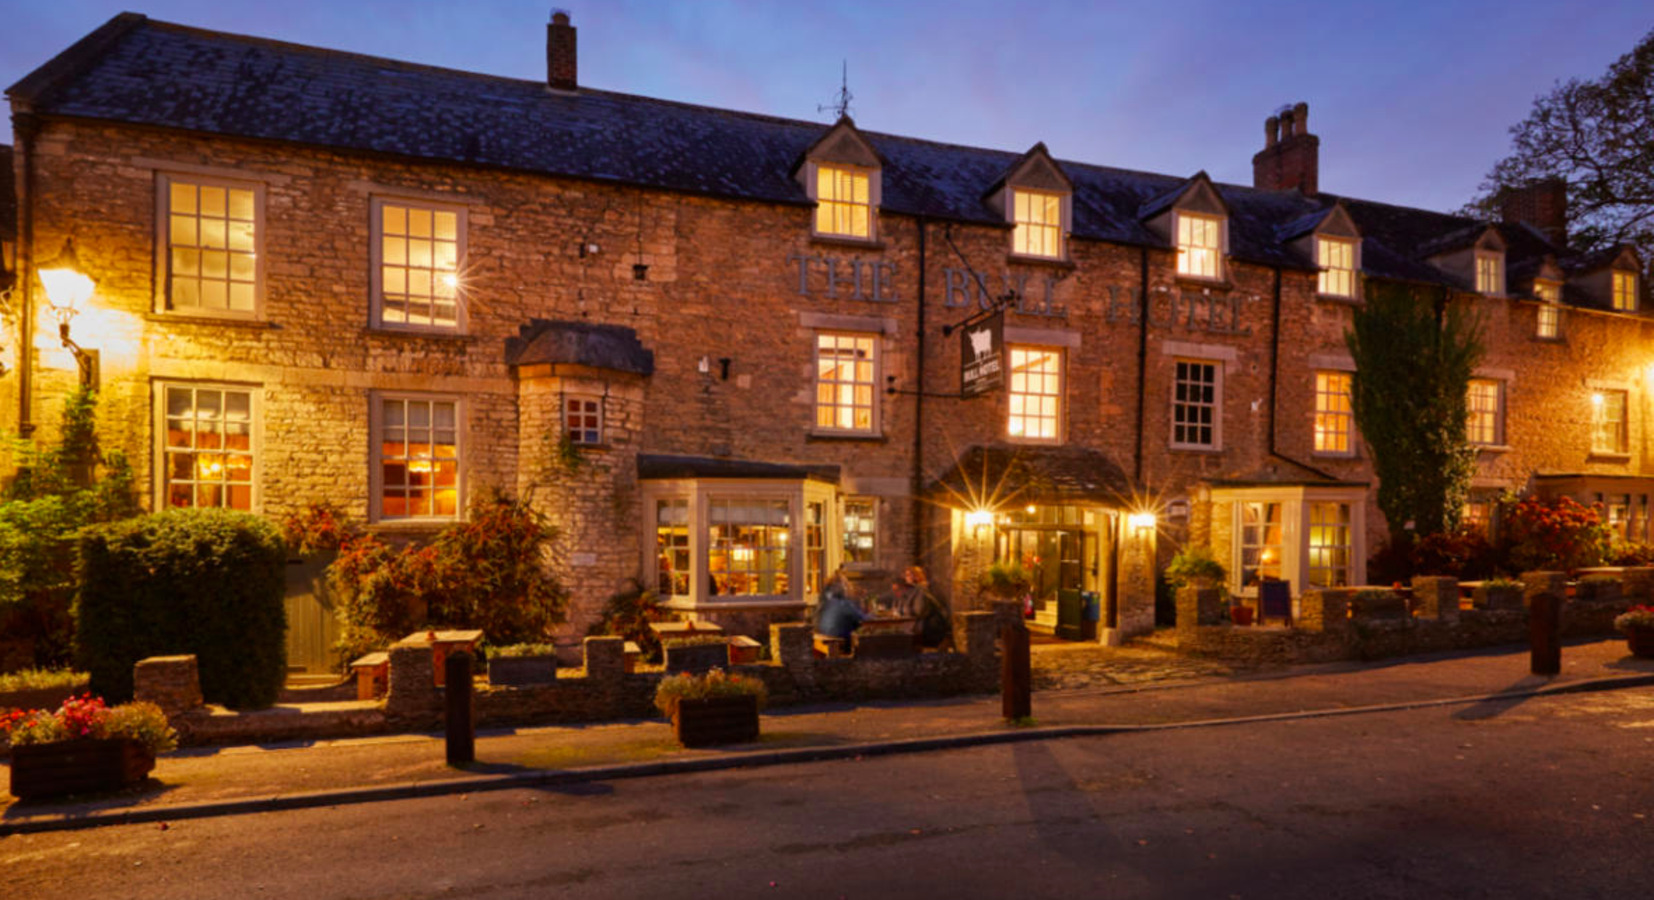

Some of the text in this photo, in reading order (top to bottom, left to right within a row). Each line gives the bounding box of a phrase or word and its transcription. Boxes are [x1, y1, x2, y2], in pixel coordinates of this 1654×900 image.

[786, 253, 1252, 336] THE BULL HOTEL
